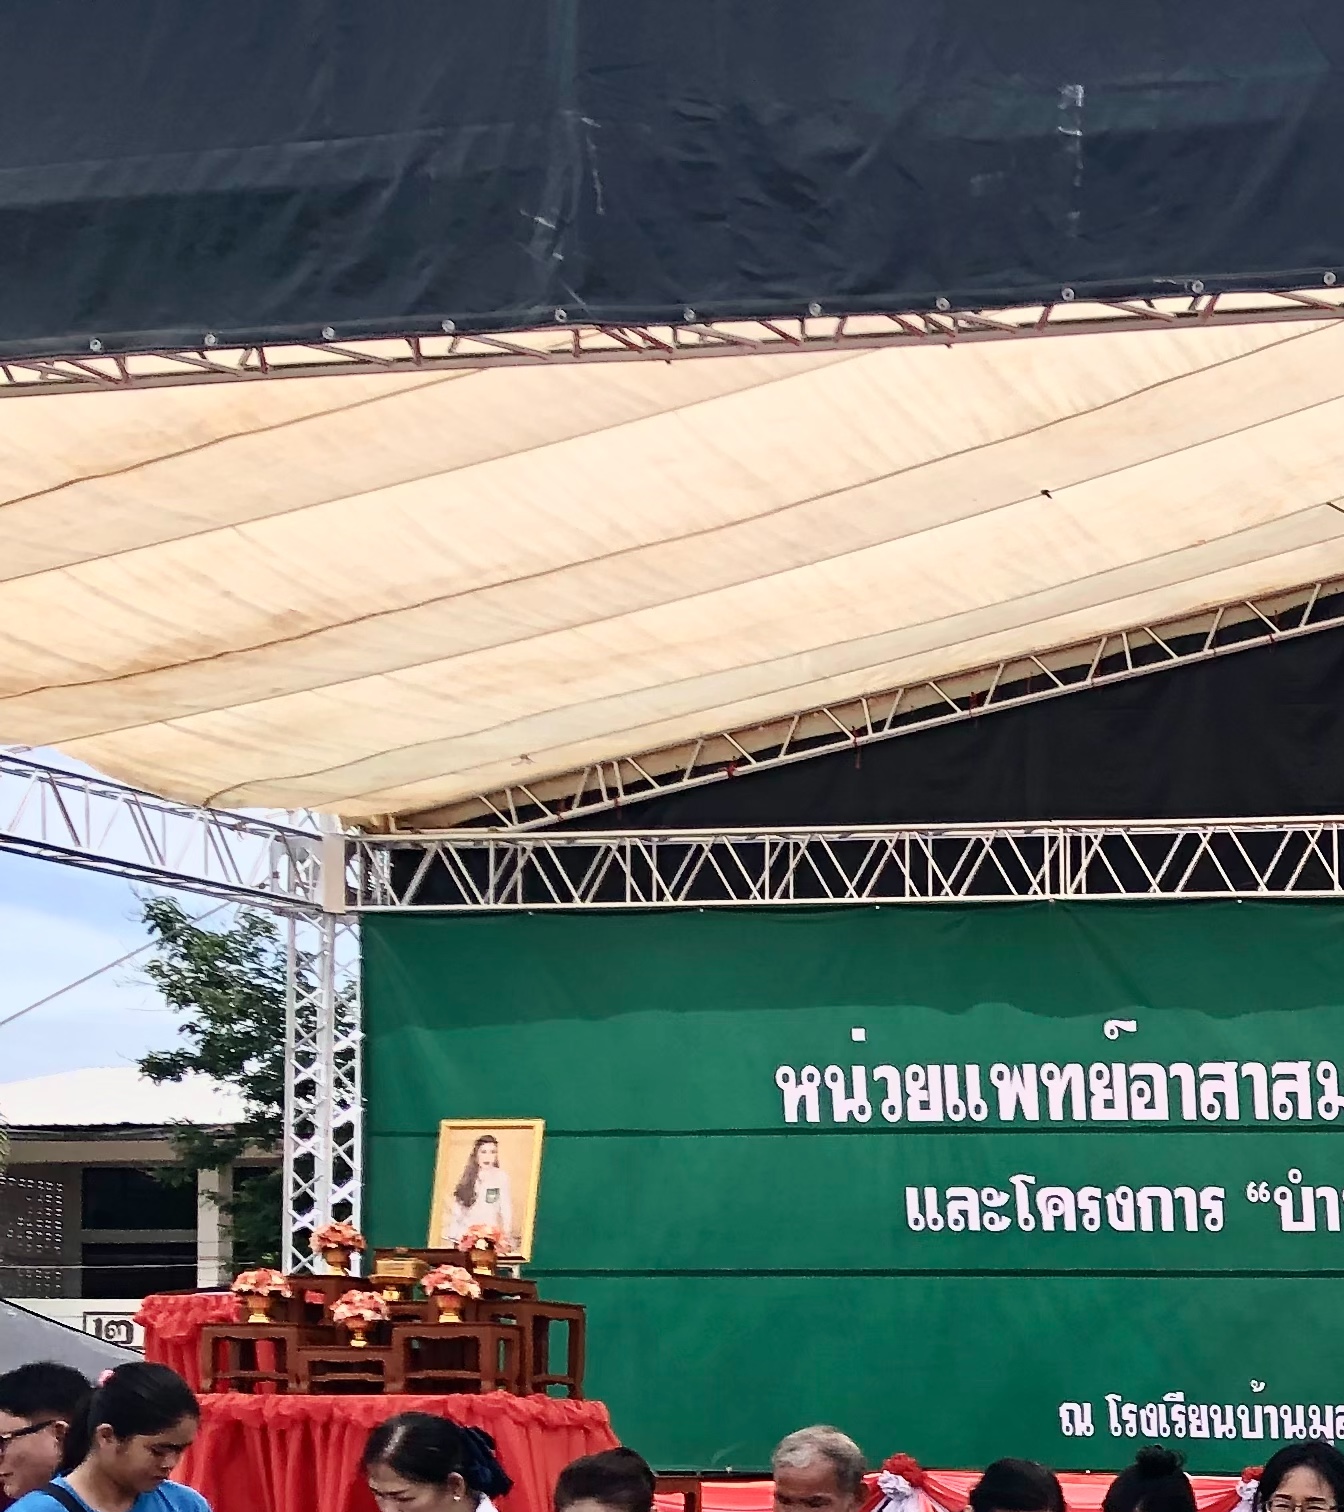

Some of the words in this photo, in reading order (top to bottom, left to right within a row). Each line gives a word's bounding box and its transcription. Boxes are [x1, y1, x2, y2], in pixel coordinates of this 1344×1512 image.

[906, 1175, 1225, 1231] และโครงการ
[1059, 1403, 1094, 1436] ณ
